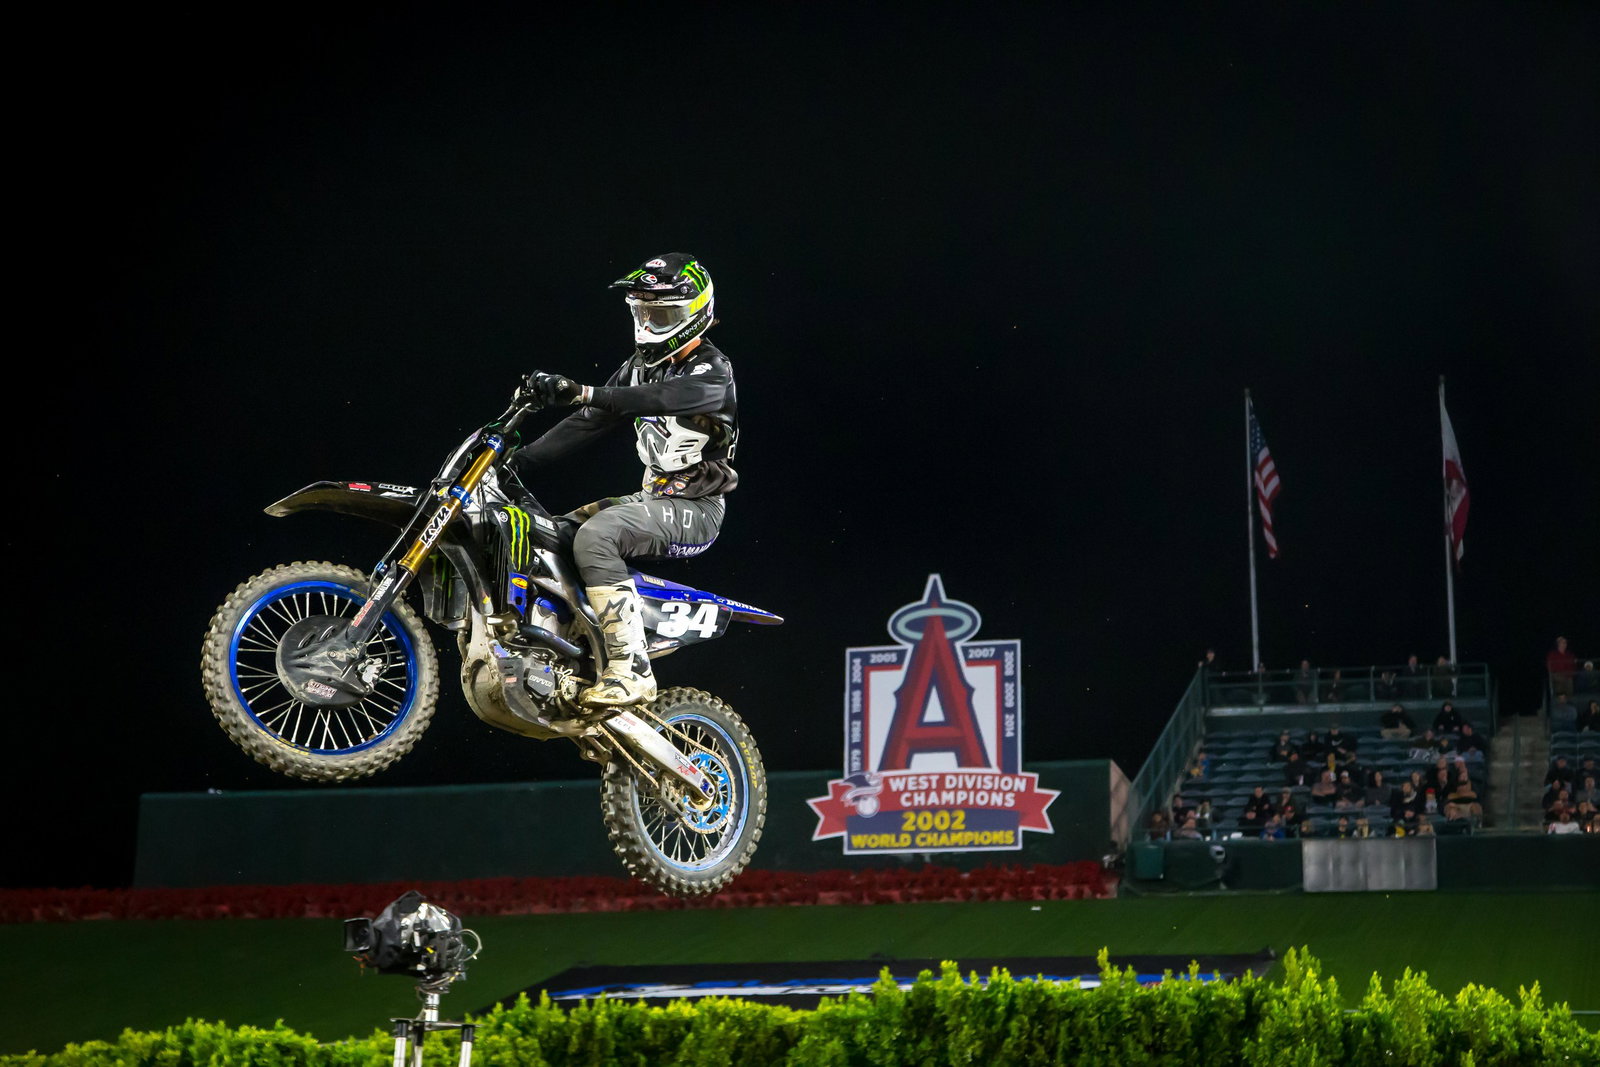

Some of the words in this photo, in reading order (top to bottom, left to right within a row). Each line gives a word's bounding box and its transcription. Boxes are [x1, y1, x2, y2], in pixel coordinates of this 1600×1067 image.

[679, 314, 707, 339] MONSTER
[656, 602, 719, 639] 34
[869, 652, 898, 664] 2005
[968, 647, 995, 659] 2007
[1004, 650, 1014, 676] 2008
[852, 658, 862, 683] 2004
[851, 690, 861, 714] 1986
[1004, 682, 1014, 708] 2009
[851, 721, 861, 743] 1982
[1004, 713, 1014, 738] 2014
[739, 741, 758, 789] DUNLOP
[851, 749, 861, 772] 1979
[888, 775, 940, 792] WEST
[945, 775, 1027, 792] DIVISION
[900, 791, 1016, 808] CHAMPIONS
[901, 810, 966, 832] 2002
[851, 833, 912, 849] WORLD
[915, 830, 1015, 847] CHAMPIONS
